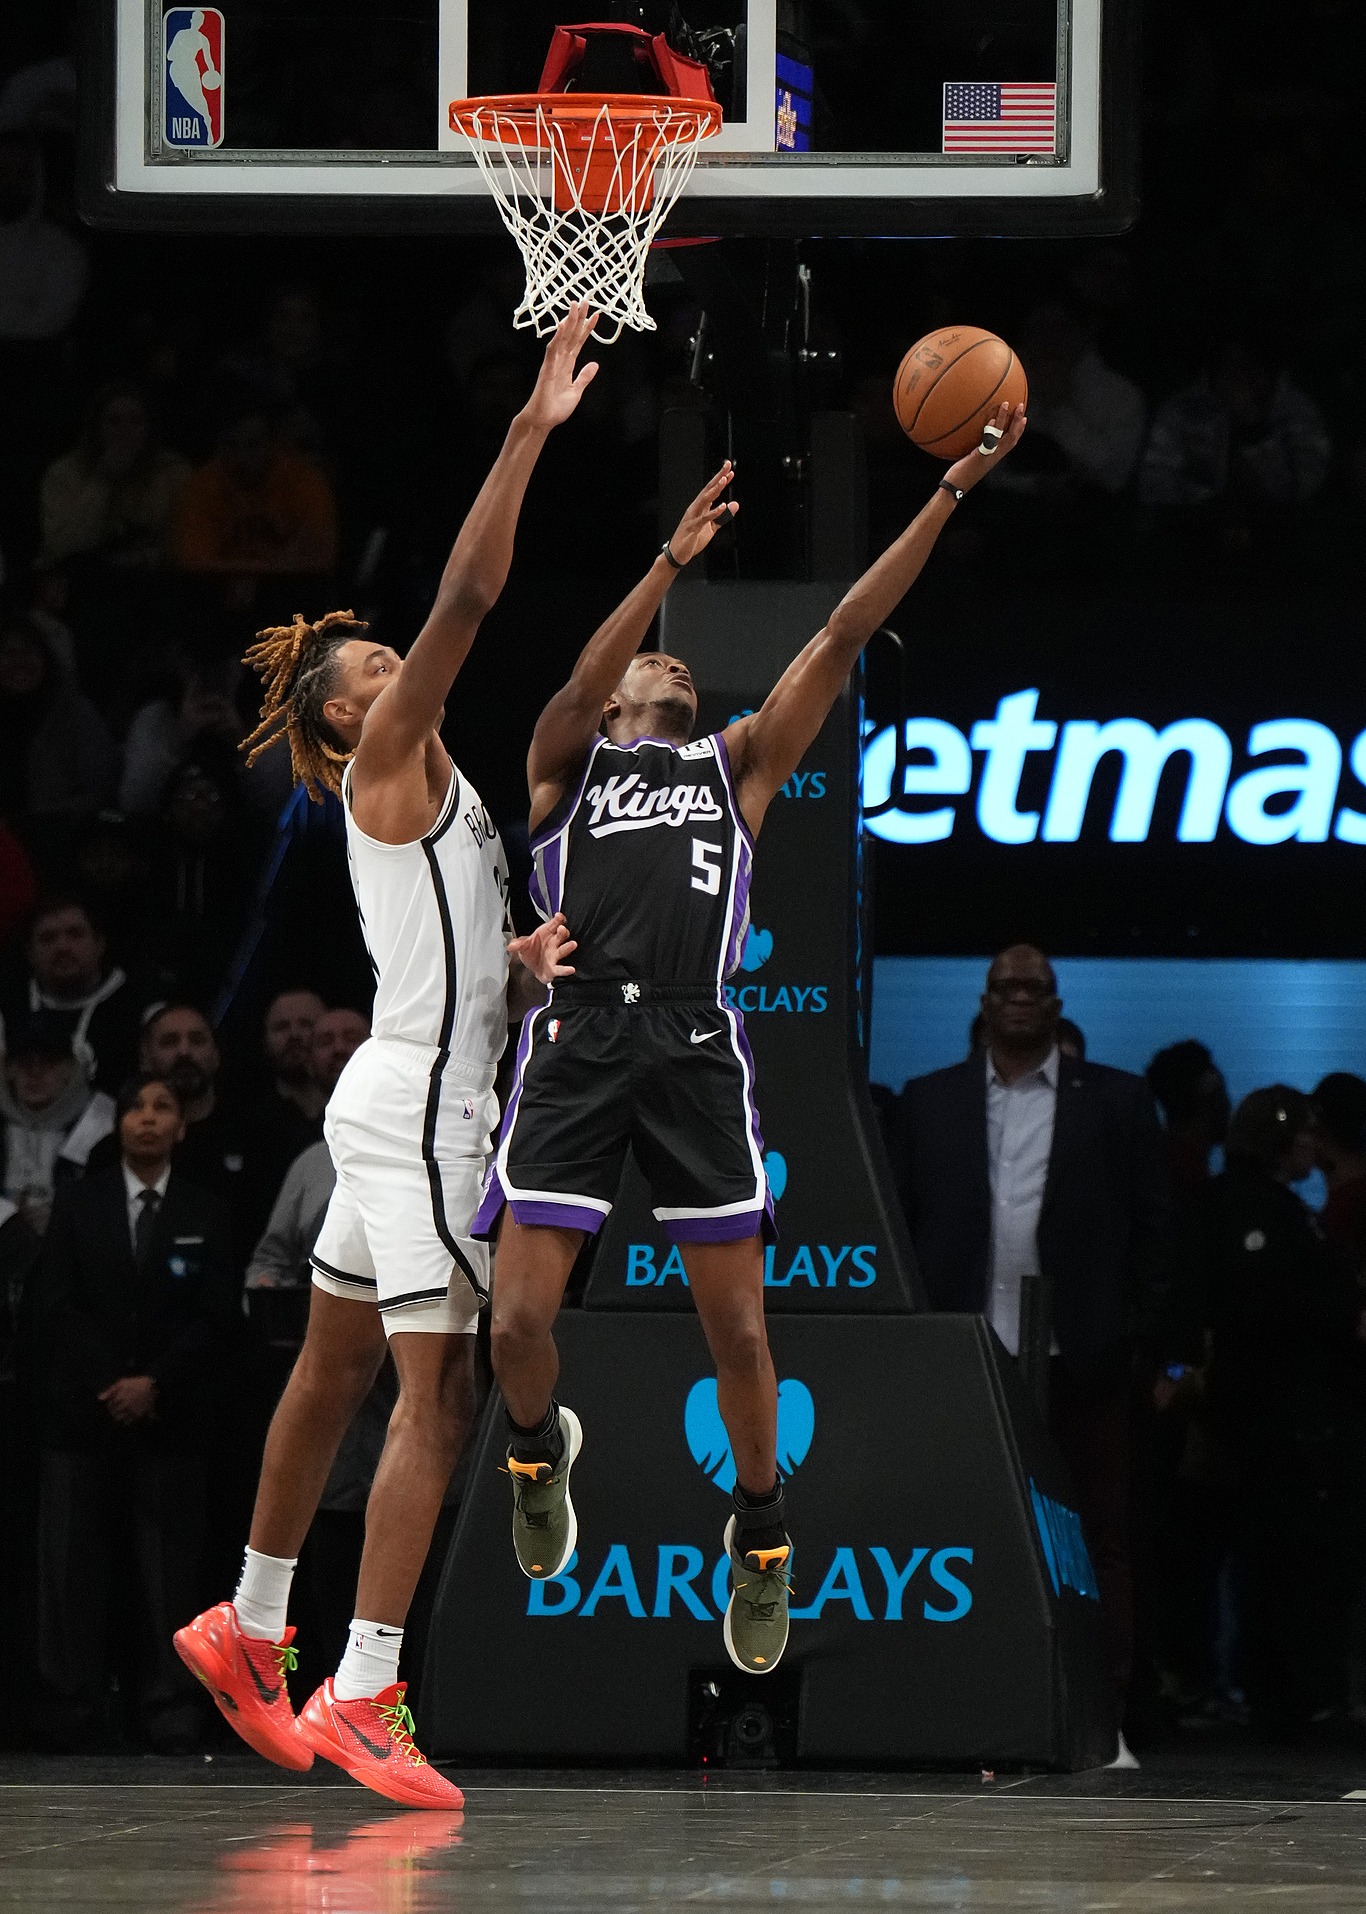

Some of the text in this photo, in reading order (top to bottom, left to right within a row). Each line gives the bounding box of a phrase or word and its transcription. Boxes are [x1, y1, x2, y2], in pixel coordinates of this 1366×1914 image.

[172, 117, 201, 139] NBA
[585, 773, 724, 840] Kings
[690, 837, 723, 896] 5
[723, 985, 829, 1013] RCLAYS
[625, 1244, 878, 1288] BALAYS
